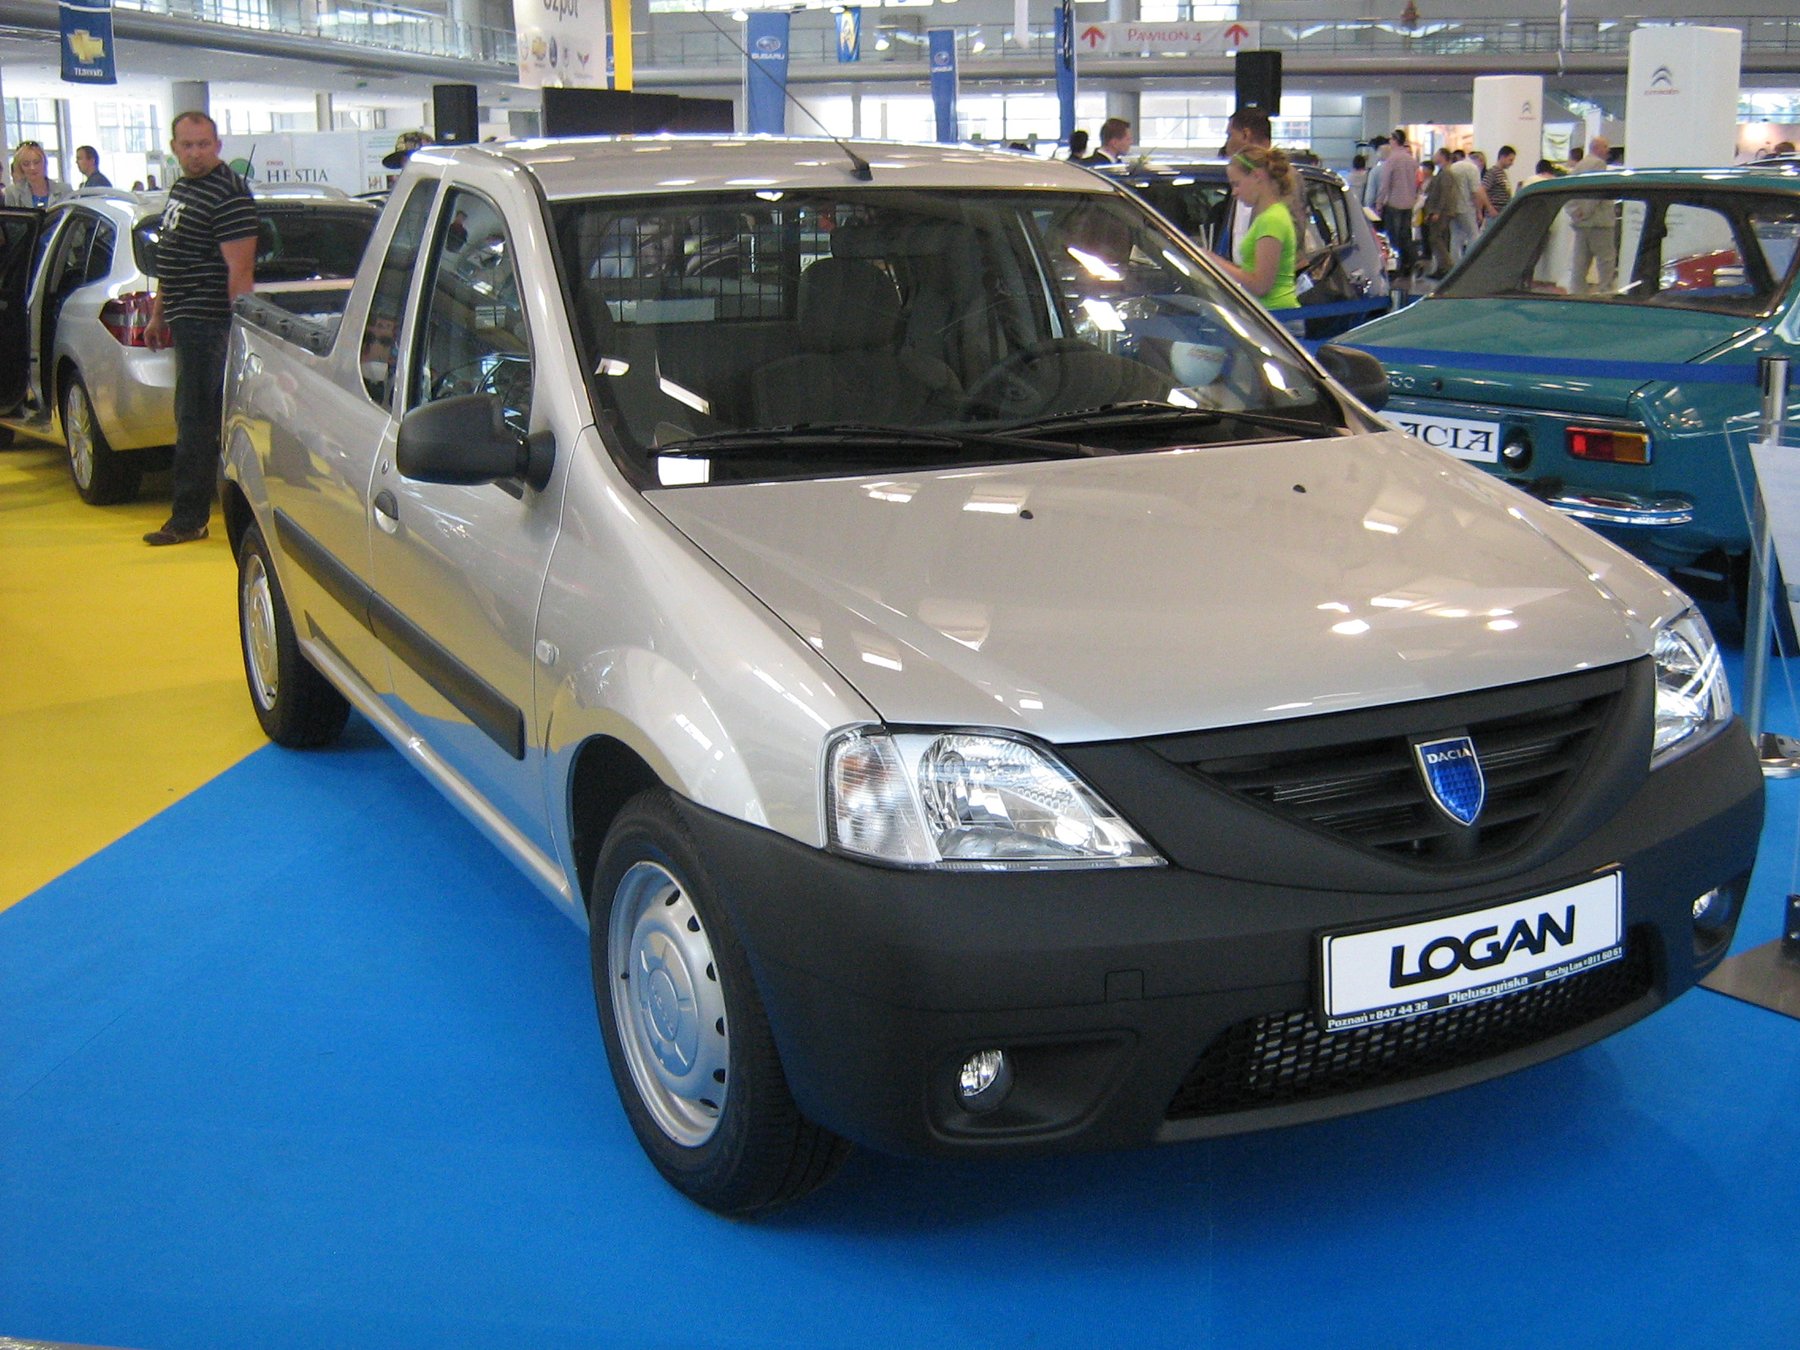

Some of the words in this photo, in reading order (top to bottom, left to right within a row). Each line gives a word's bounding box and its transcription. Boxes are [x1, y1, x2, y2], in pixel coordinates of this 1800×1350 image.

[1396, 420, 1494, 453] ACIA
[1426, 747, 1473, 764] DACIA
[1389, 904, 1576, 989] LOGAN
[1327, 1012, 1369, 1029] Poznań
[1376, 1007, 1397, 1020] 847
[1398, 1004, 1413, 1015] 44
[1414, 1001, 1429, 1012] 32
